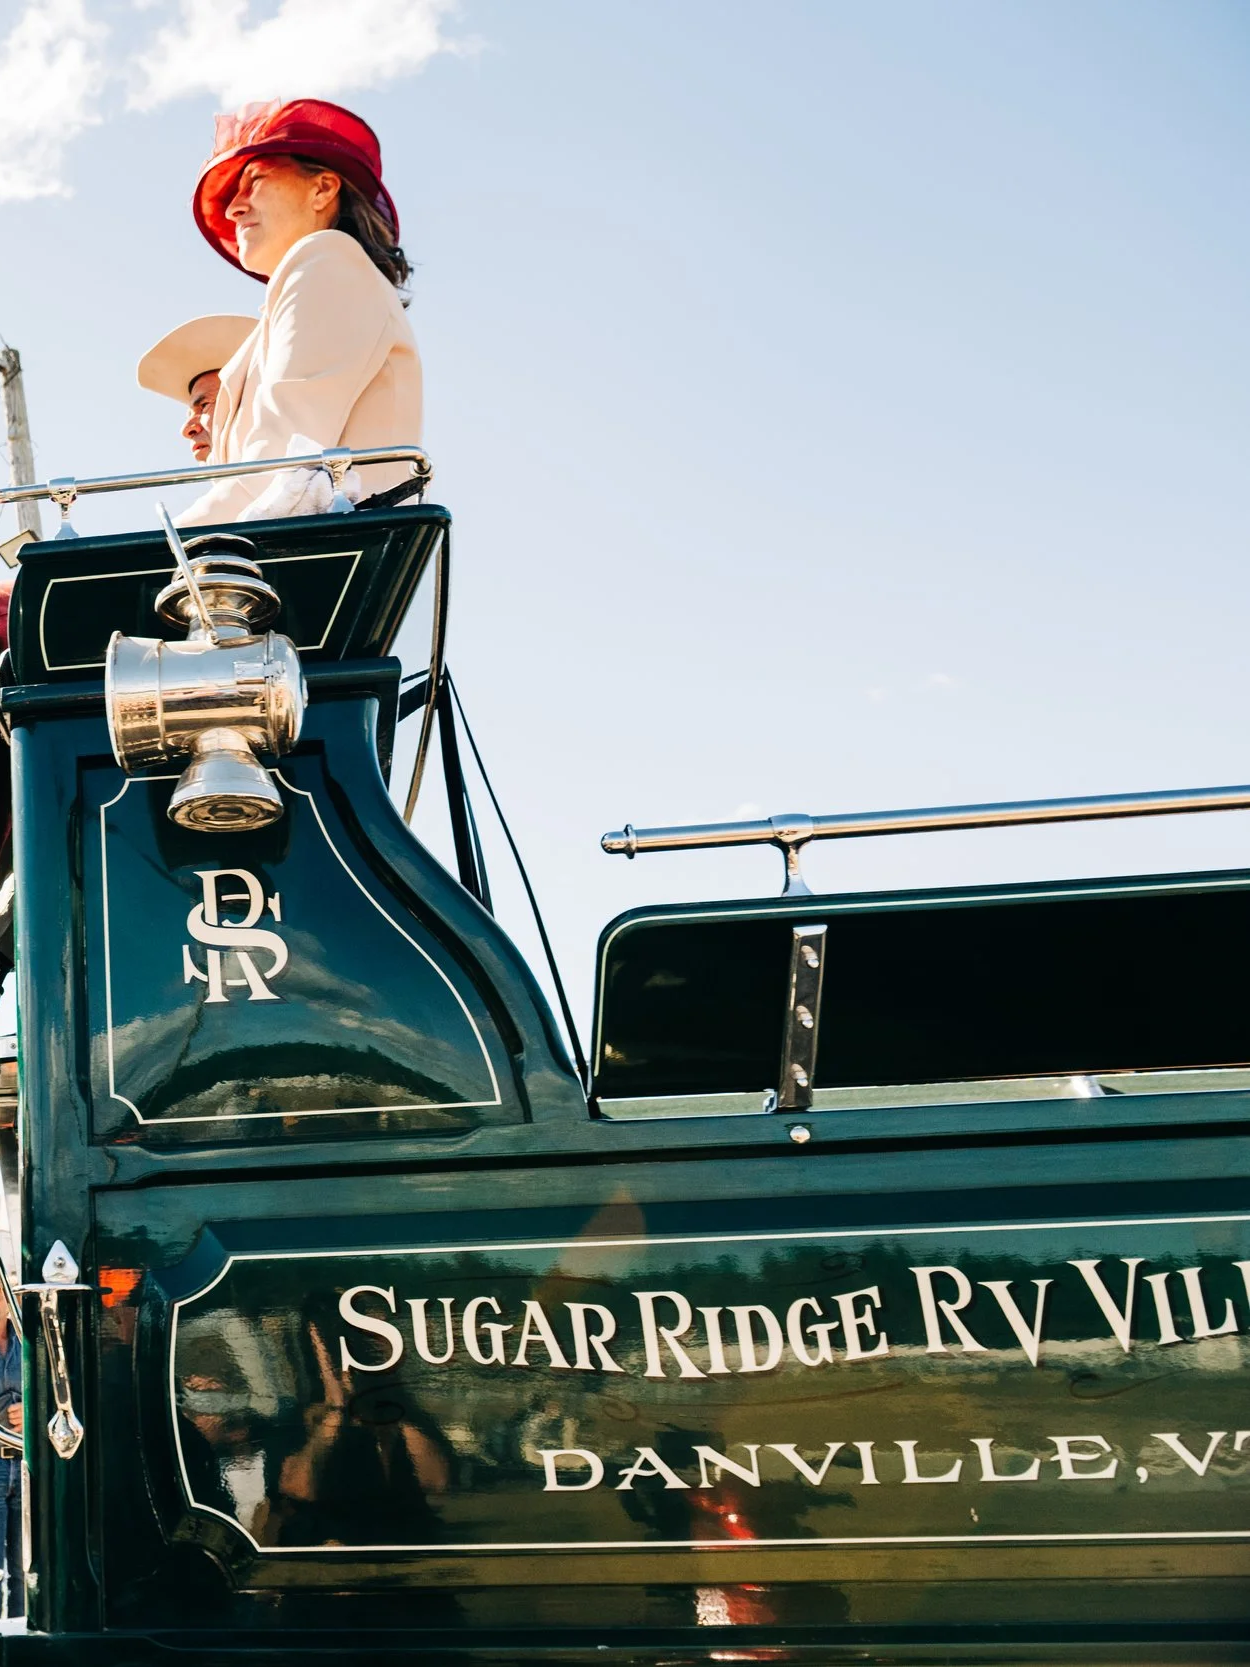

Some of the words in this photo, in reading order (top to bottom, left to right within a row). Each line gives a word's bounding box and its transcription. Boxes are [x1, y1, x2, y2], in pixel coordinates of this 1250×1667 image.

[338, 1285, 625, 1373] SUGAR
[631, 1285, 889, 1378] RIDGE
[908, 1265, 1054, 1367] RV
